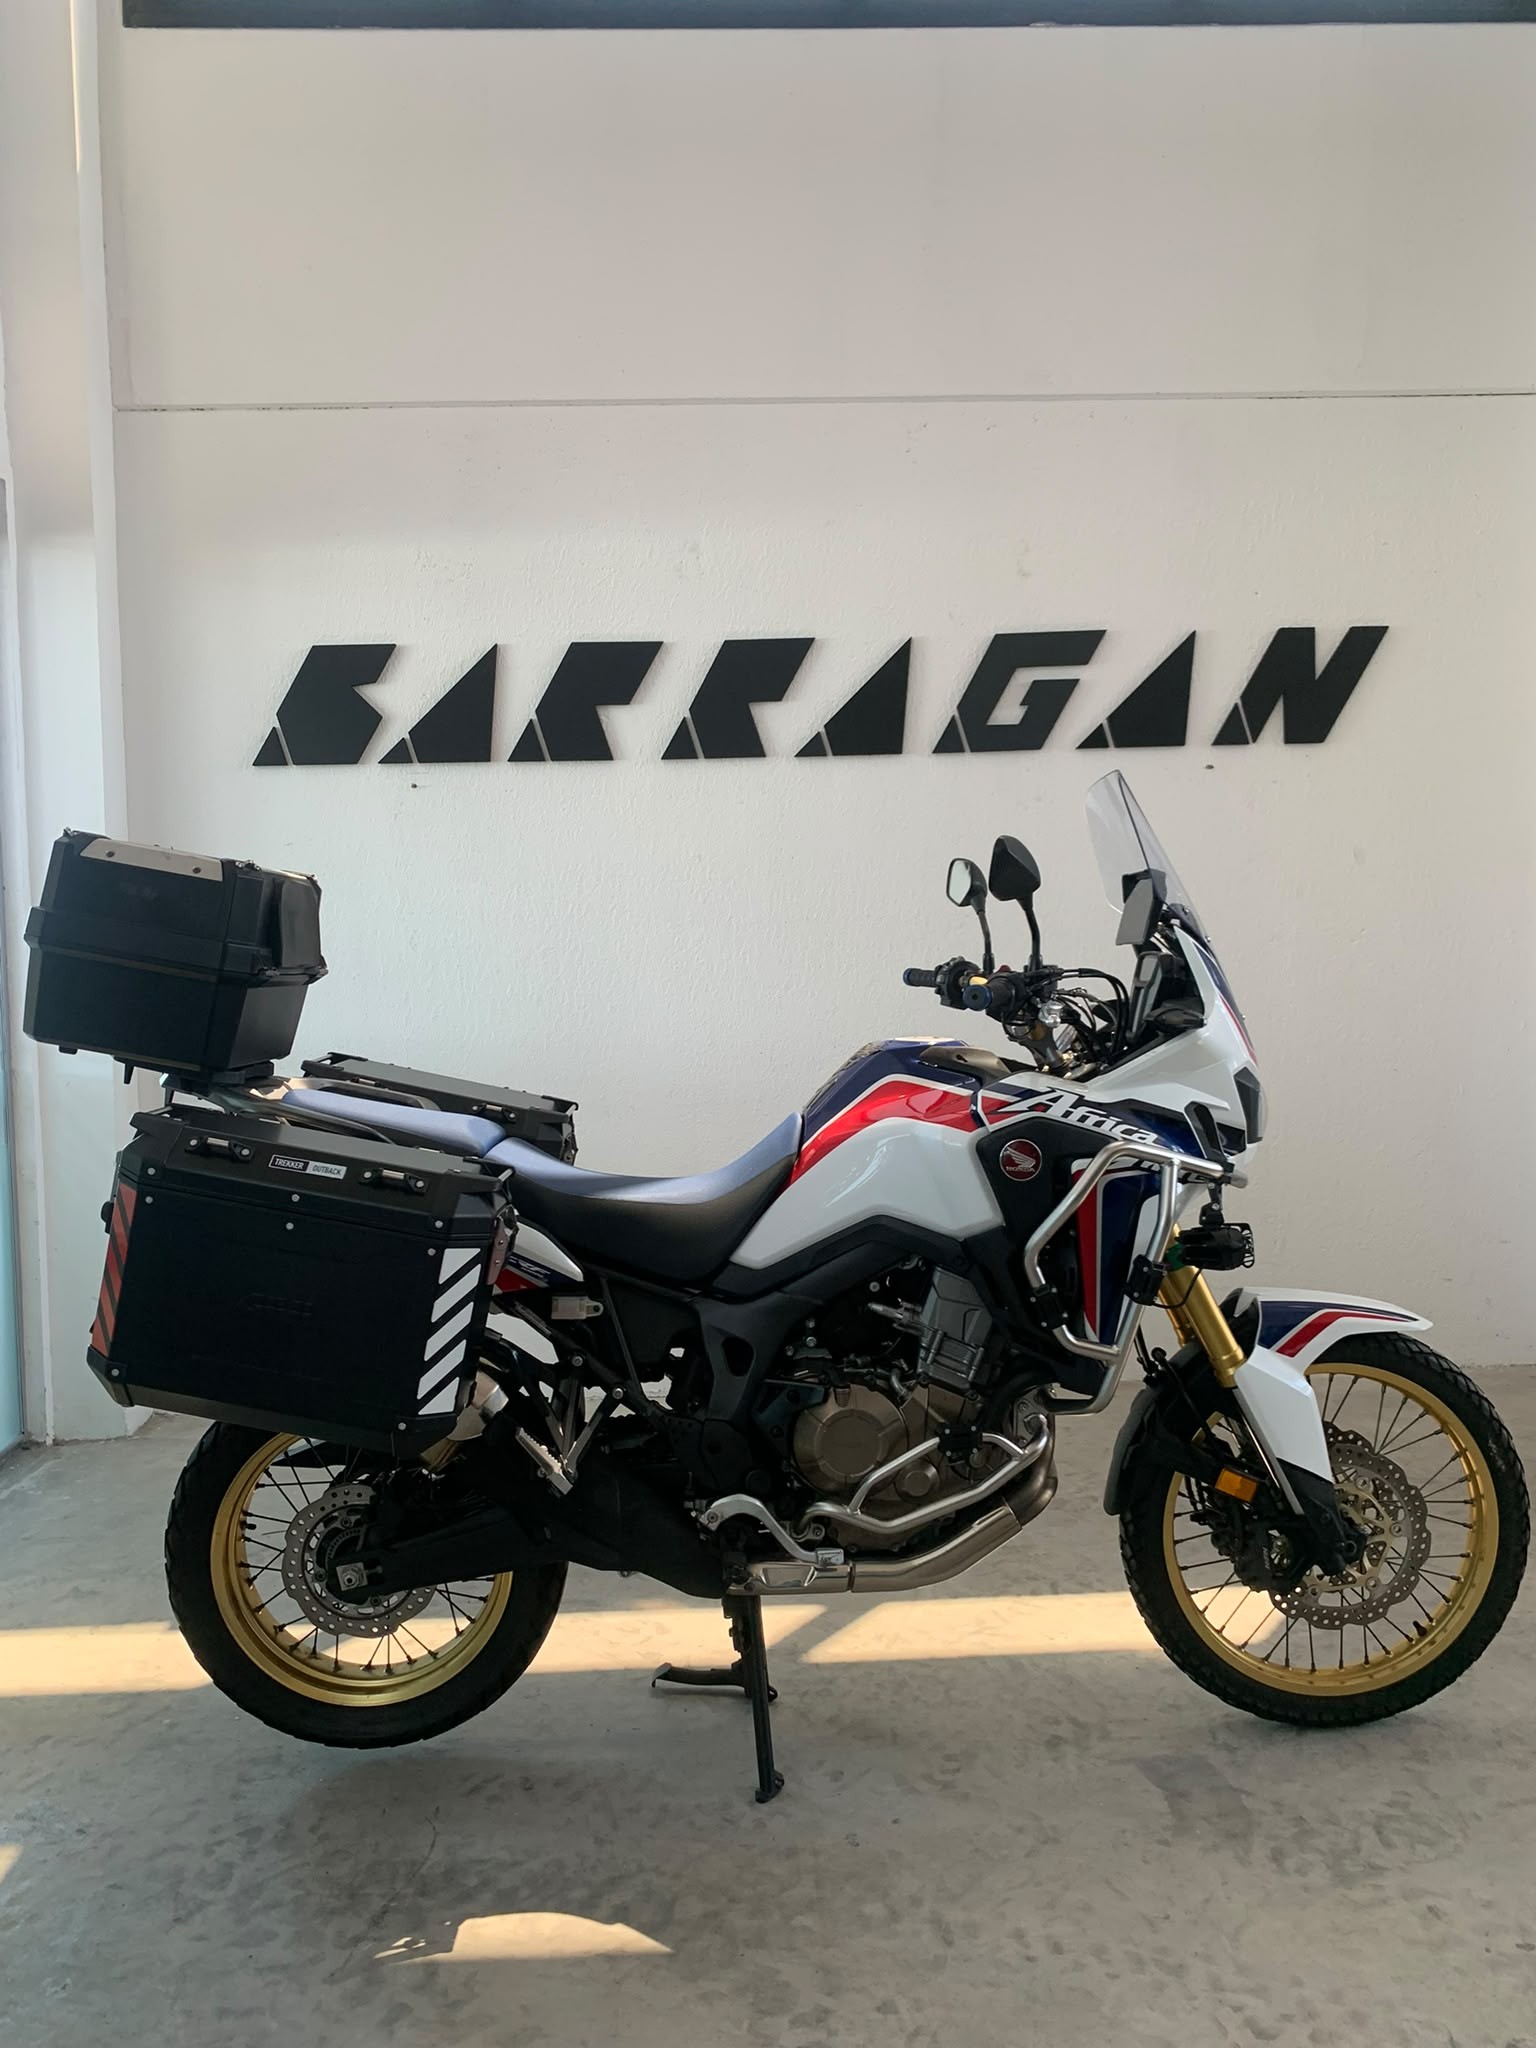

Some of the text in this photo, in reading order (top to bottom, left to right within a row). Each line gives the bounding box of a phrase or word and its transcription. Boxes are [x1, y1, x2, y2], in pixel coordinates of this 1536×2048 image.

[252, 625, 1391, 767] BARRAGAN
[997, 1087, 1168, 1149] Africa
[274, 1158, 342, 1176] TREKKER OUTBACK
